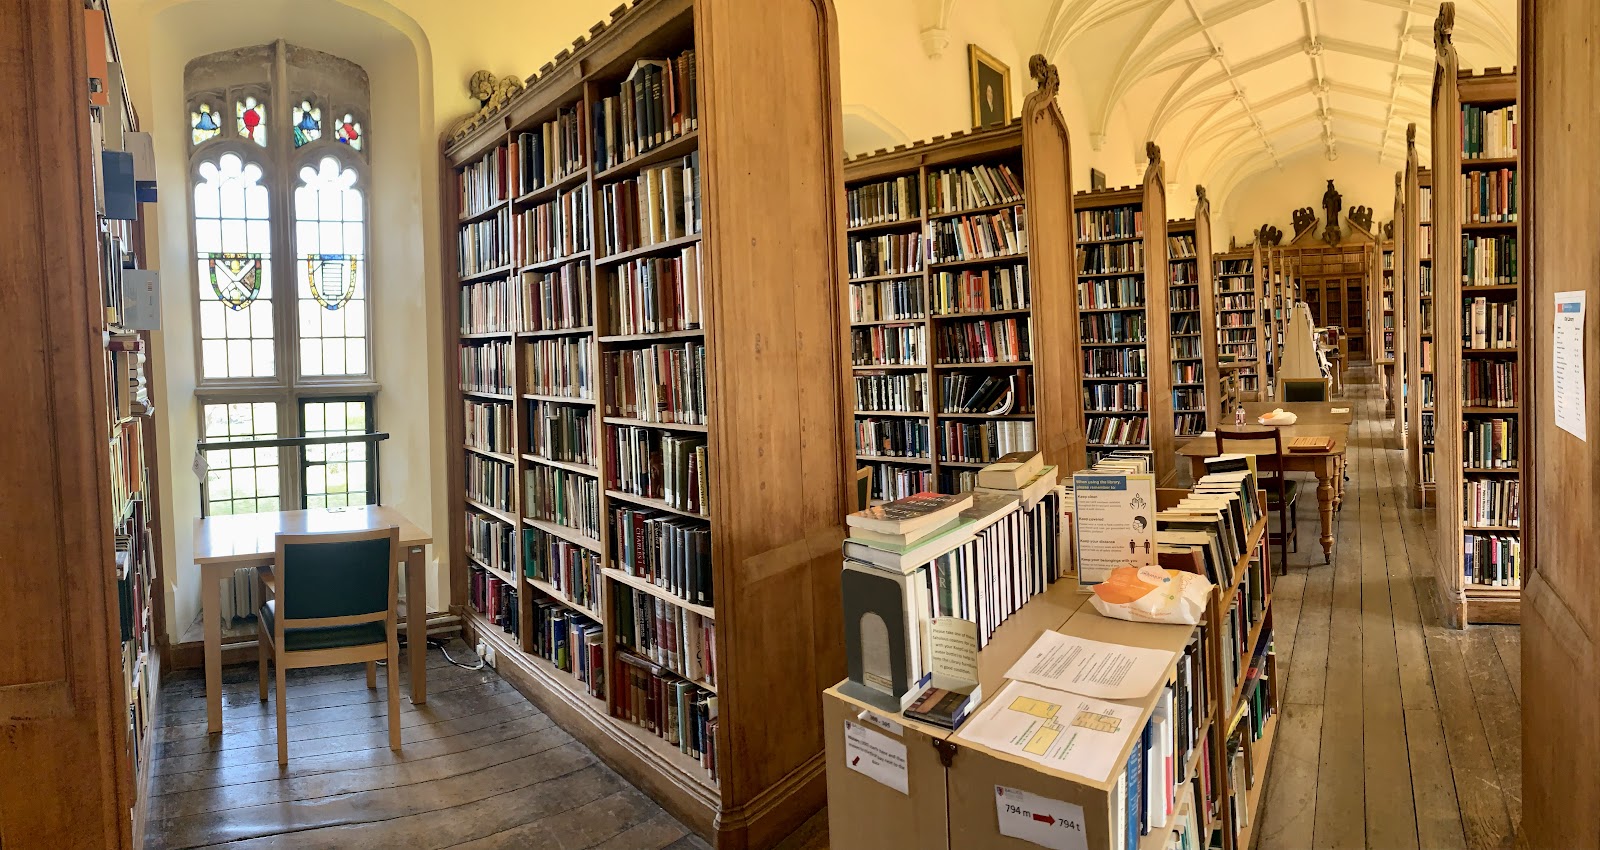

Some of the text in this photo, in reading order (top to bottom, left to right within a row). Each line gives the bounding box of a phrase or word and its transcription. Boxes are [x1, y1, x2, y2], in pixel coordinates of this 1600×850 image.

[1005, 804, 1021, 815] 794
[1022, 810, 1031, 818] m
[1058, 818, 1075, 830] 794
